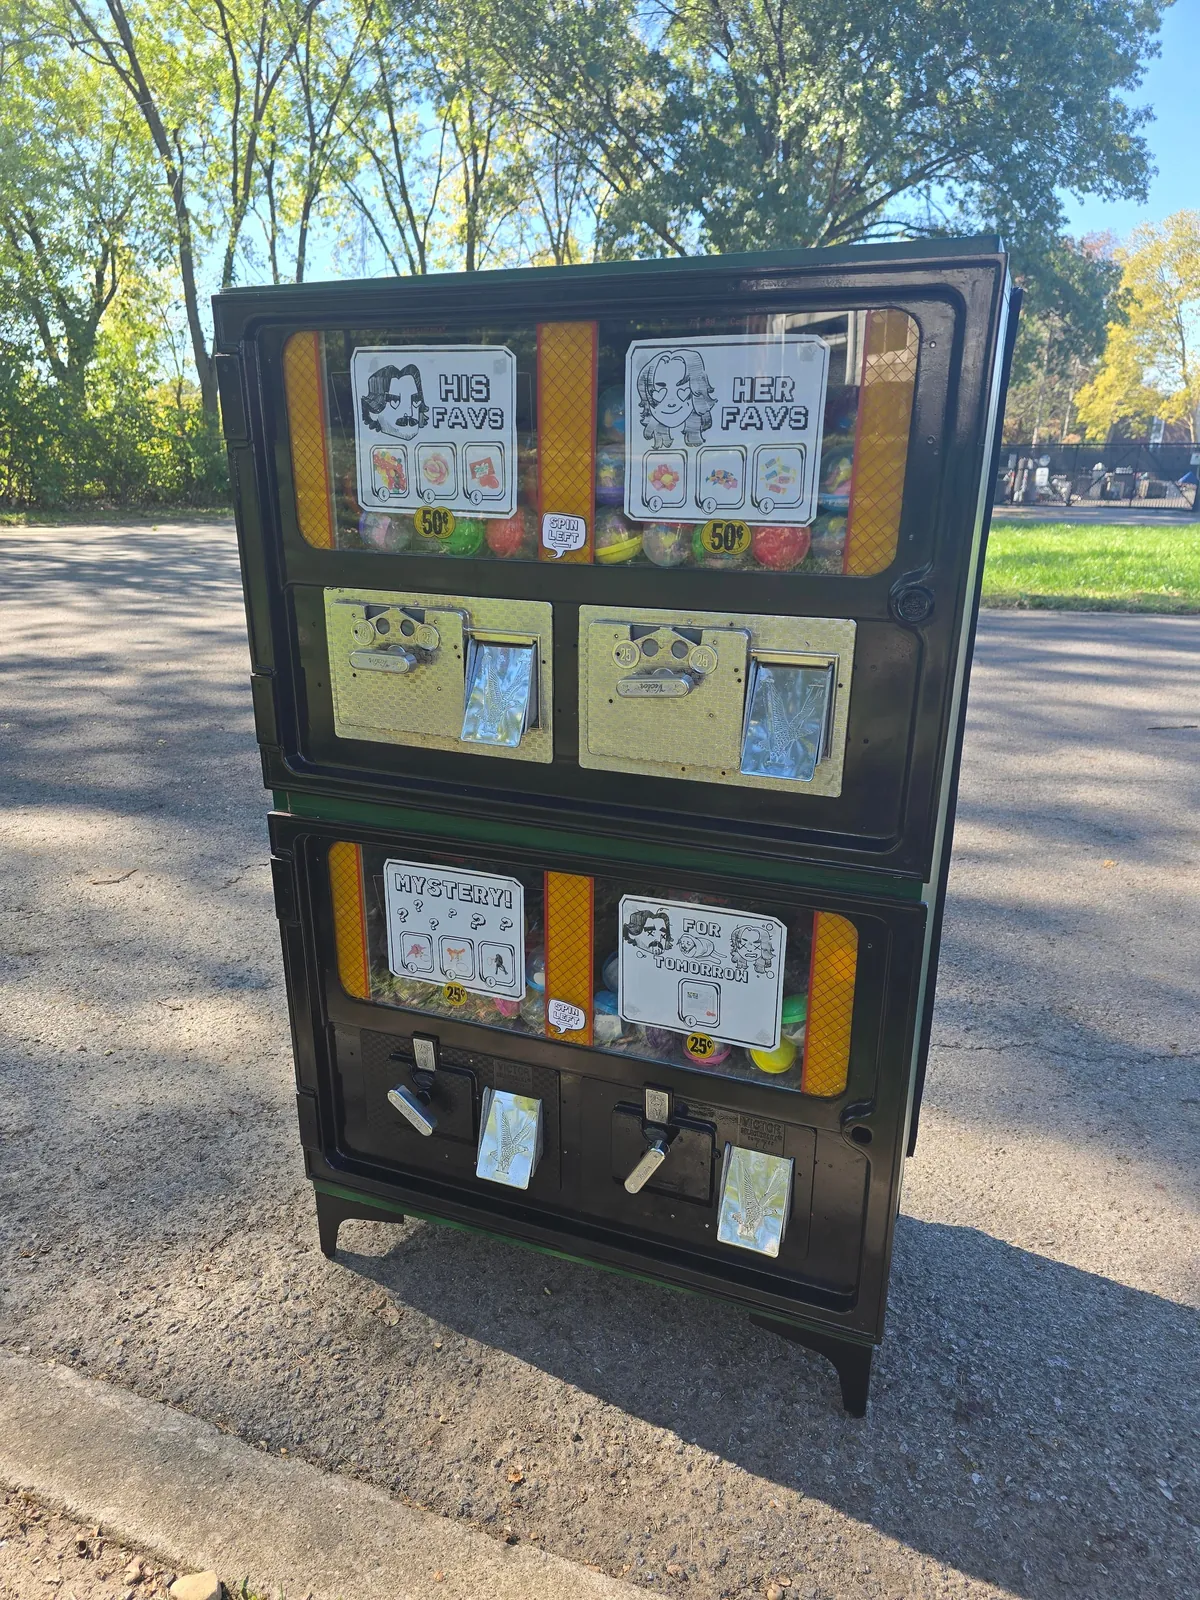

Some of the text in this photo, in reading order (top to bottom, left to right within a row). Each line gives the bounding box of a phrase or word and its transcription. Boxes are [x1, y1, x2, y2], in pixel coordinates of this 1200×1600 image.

[439, 374, 490, 402] HIS
[732, 376, 795, 403] HER
[432, 407, 504, 430] FAVS
[721, 406, 809, 430] FAVS
[422, 509, 450, 535] 50¢
[550, 517, 579, 531] SPIN
[548, 530, 579, 543] LEFT
[710, 522, 745, 550] 50¢
[620, 648, 631, 661] 25
[697, 654, 708, 667] 25
[638, 683, 666, 694] Victor
[395, 873, 513, 909] MYSTERY!
[683, 918, 722, 938] FOR
[653, 954, 749, 984] TOMORROW
[446, 985, 466, 1003] 25¢
[553, 1011, 580, 1025] LEFT
[554, 1002, 580, 1016] SPIN
[690, 1036, 713, 1055] 25¢
[740, 1115, 782, 1134] VICTOR
